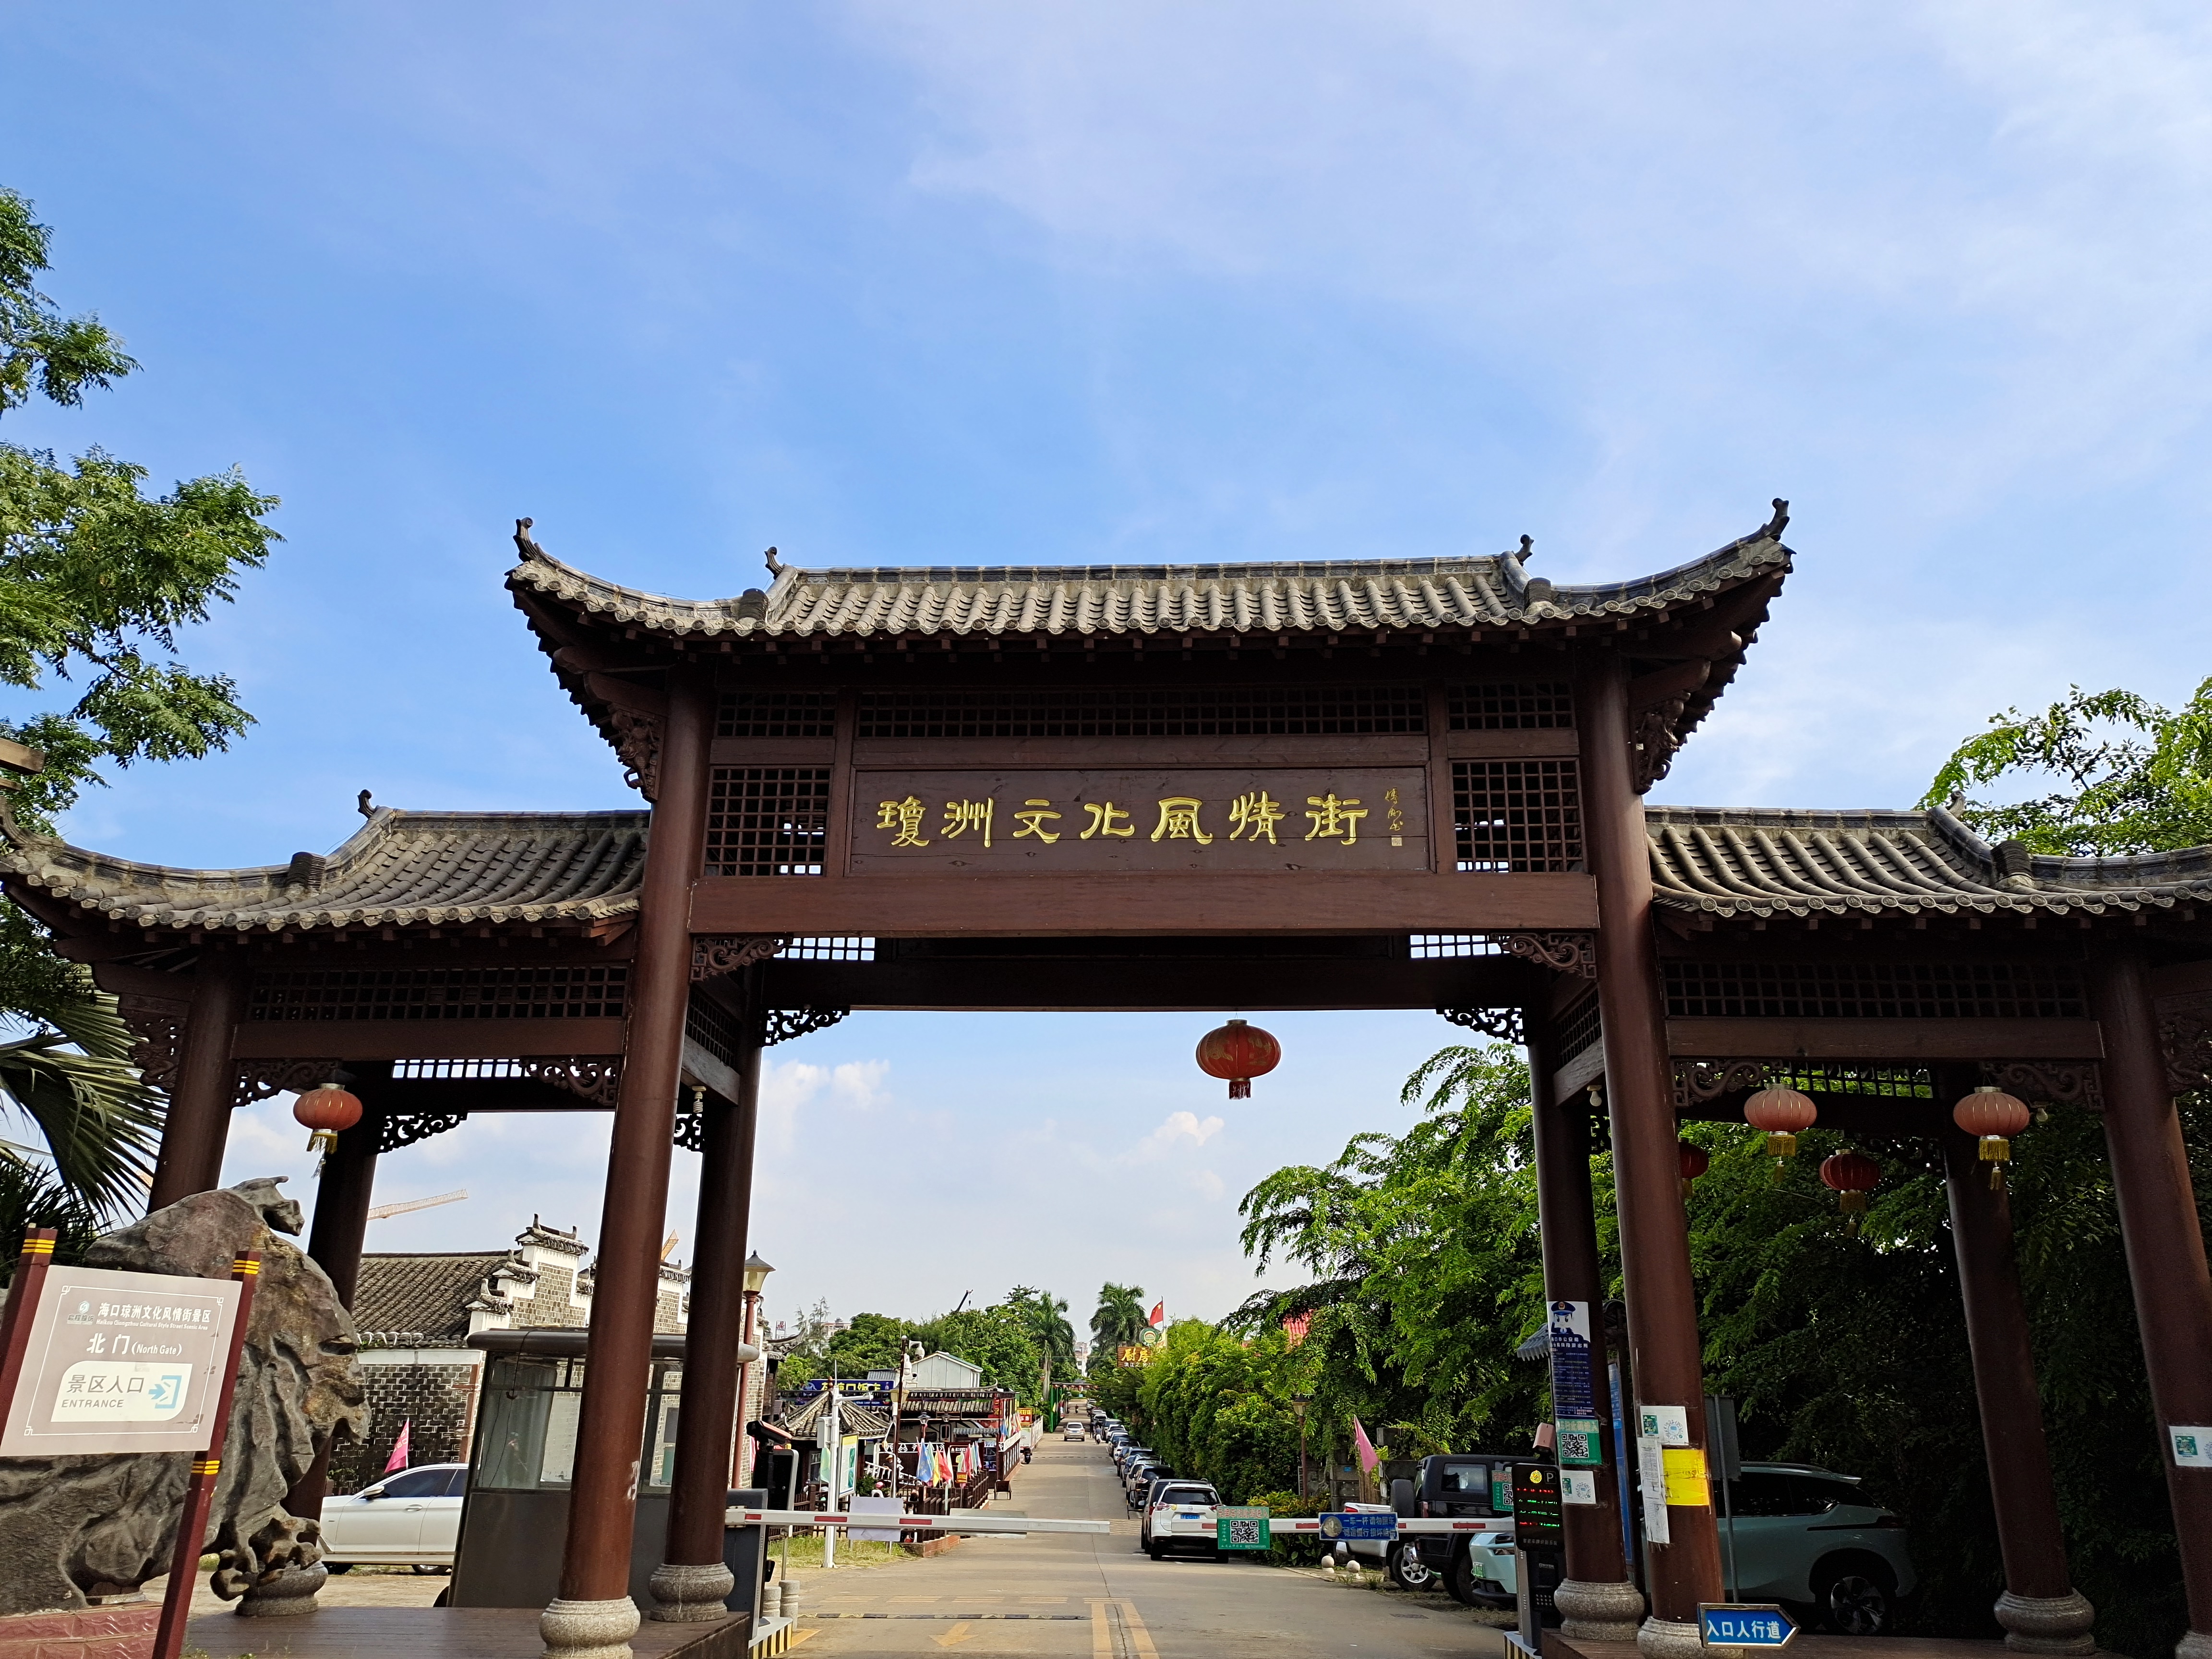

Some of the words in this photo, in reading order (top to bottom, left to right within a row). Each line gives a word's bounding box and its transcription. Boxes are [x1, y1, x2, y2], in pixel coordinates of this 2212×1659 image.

[877, 791, 1368, 847] 瓊洲文化風情街
[159, 1343, 182, 1356] Gate)
[61, 1399, 124, 1407] ENTRANCE
[1546, 1472, 1553, 1482] P
[1707, 1619, 1780, 1639] 入口人行道
